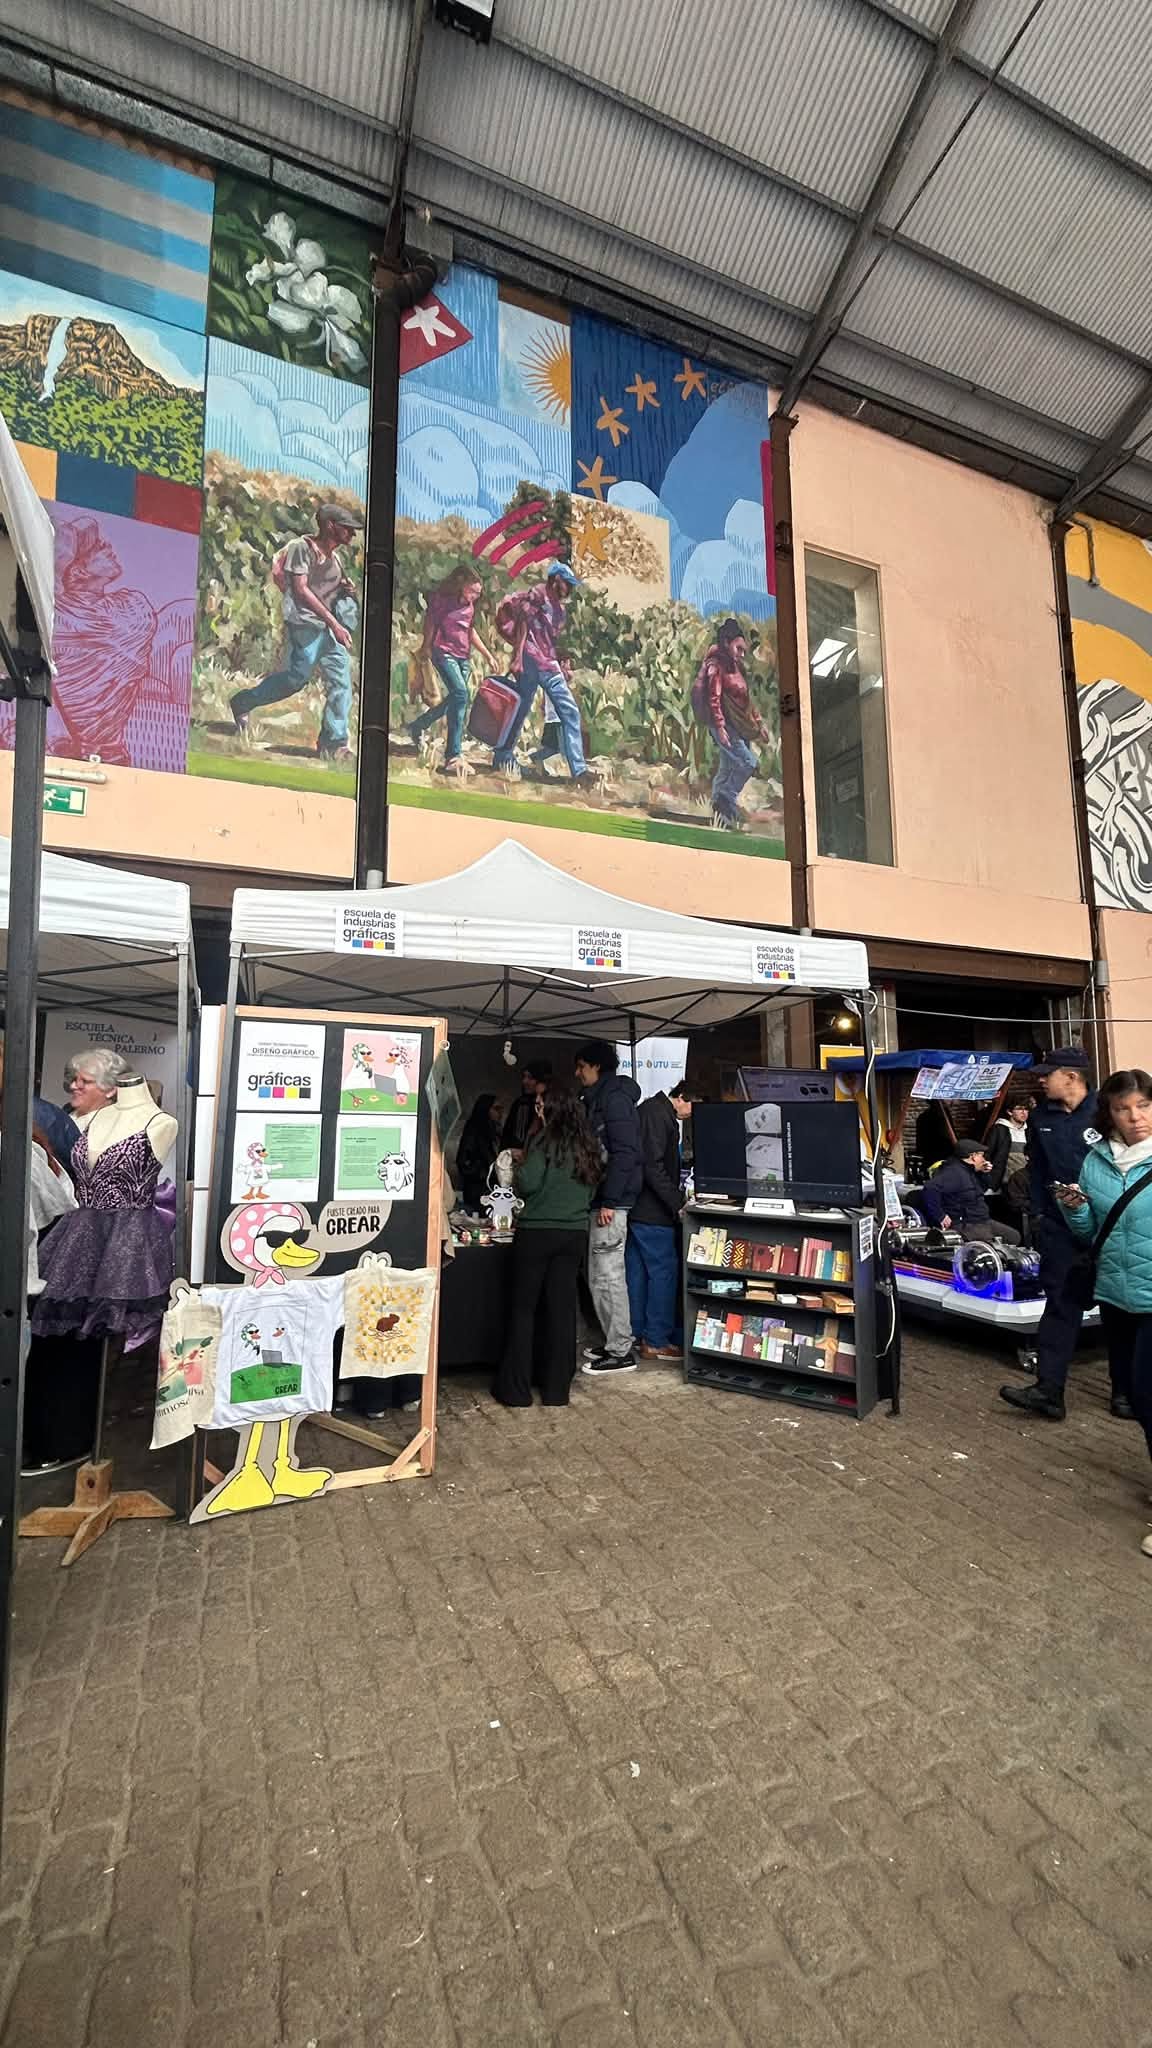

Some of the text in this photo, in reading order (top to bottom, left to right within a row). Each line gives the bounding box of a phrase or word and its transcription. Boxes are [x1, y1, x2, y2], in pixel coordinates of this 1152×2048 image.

[344, 909, 396, 920] escuela de
[344, 916, 396, 928] industrias
[343, 927, 396, 942] gráficas
[578, 929, 622, 940] escuela de
[578, 937, 622, 948] industrias
[578, 946, 622, 960] gráficas
[757, 945, 794, 954] escuela de
[757, 952, 794, 961] industrias
[757, 961, 795, 974] gráficas
[65, 1022, 114, 1033] ESCUELA
[88, 1032, 135, 1044] TÉCNICA
[115, 1044, 166, 1055] PALERMO
[252, 1046, 281, 1055] DISEÑO
[281, 1048, 315, 1056] GRÁFICO
[622, 1060, 643, 1069] ANP
[653, 1060, 669, 1069] UTU
[247, 1070, 312, 1091] gráficas
[326, 1205, 380, 1217] FUISTE CREADO PARA
[326, 1215, 380, 1236] CREAR
[275, 1383, 298, 1395] CREAR
